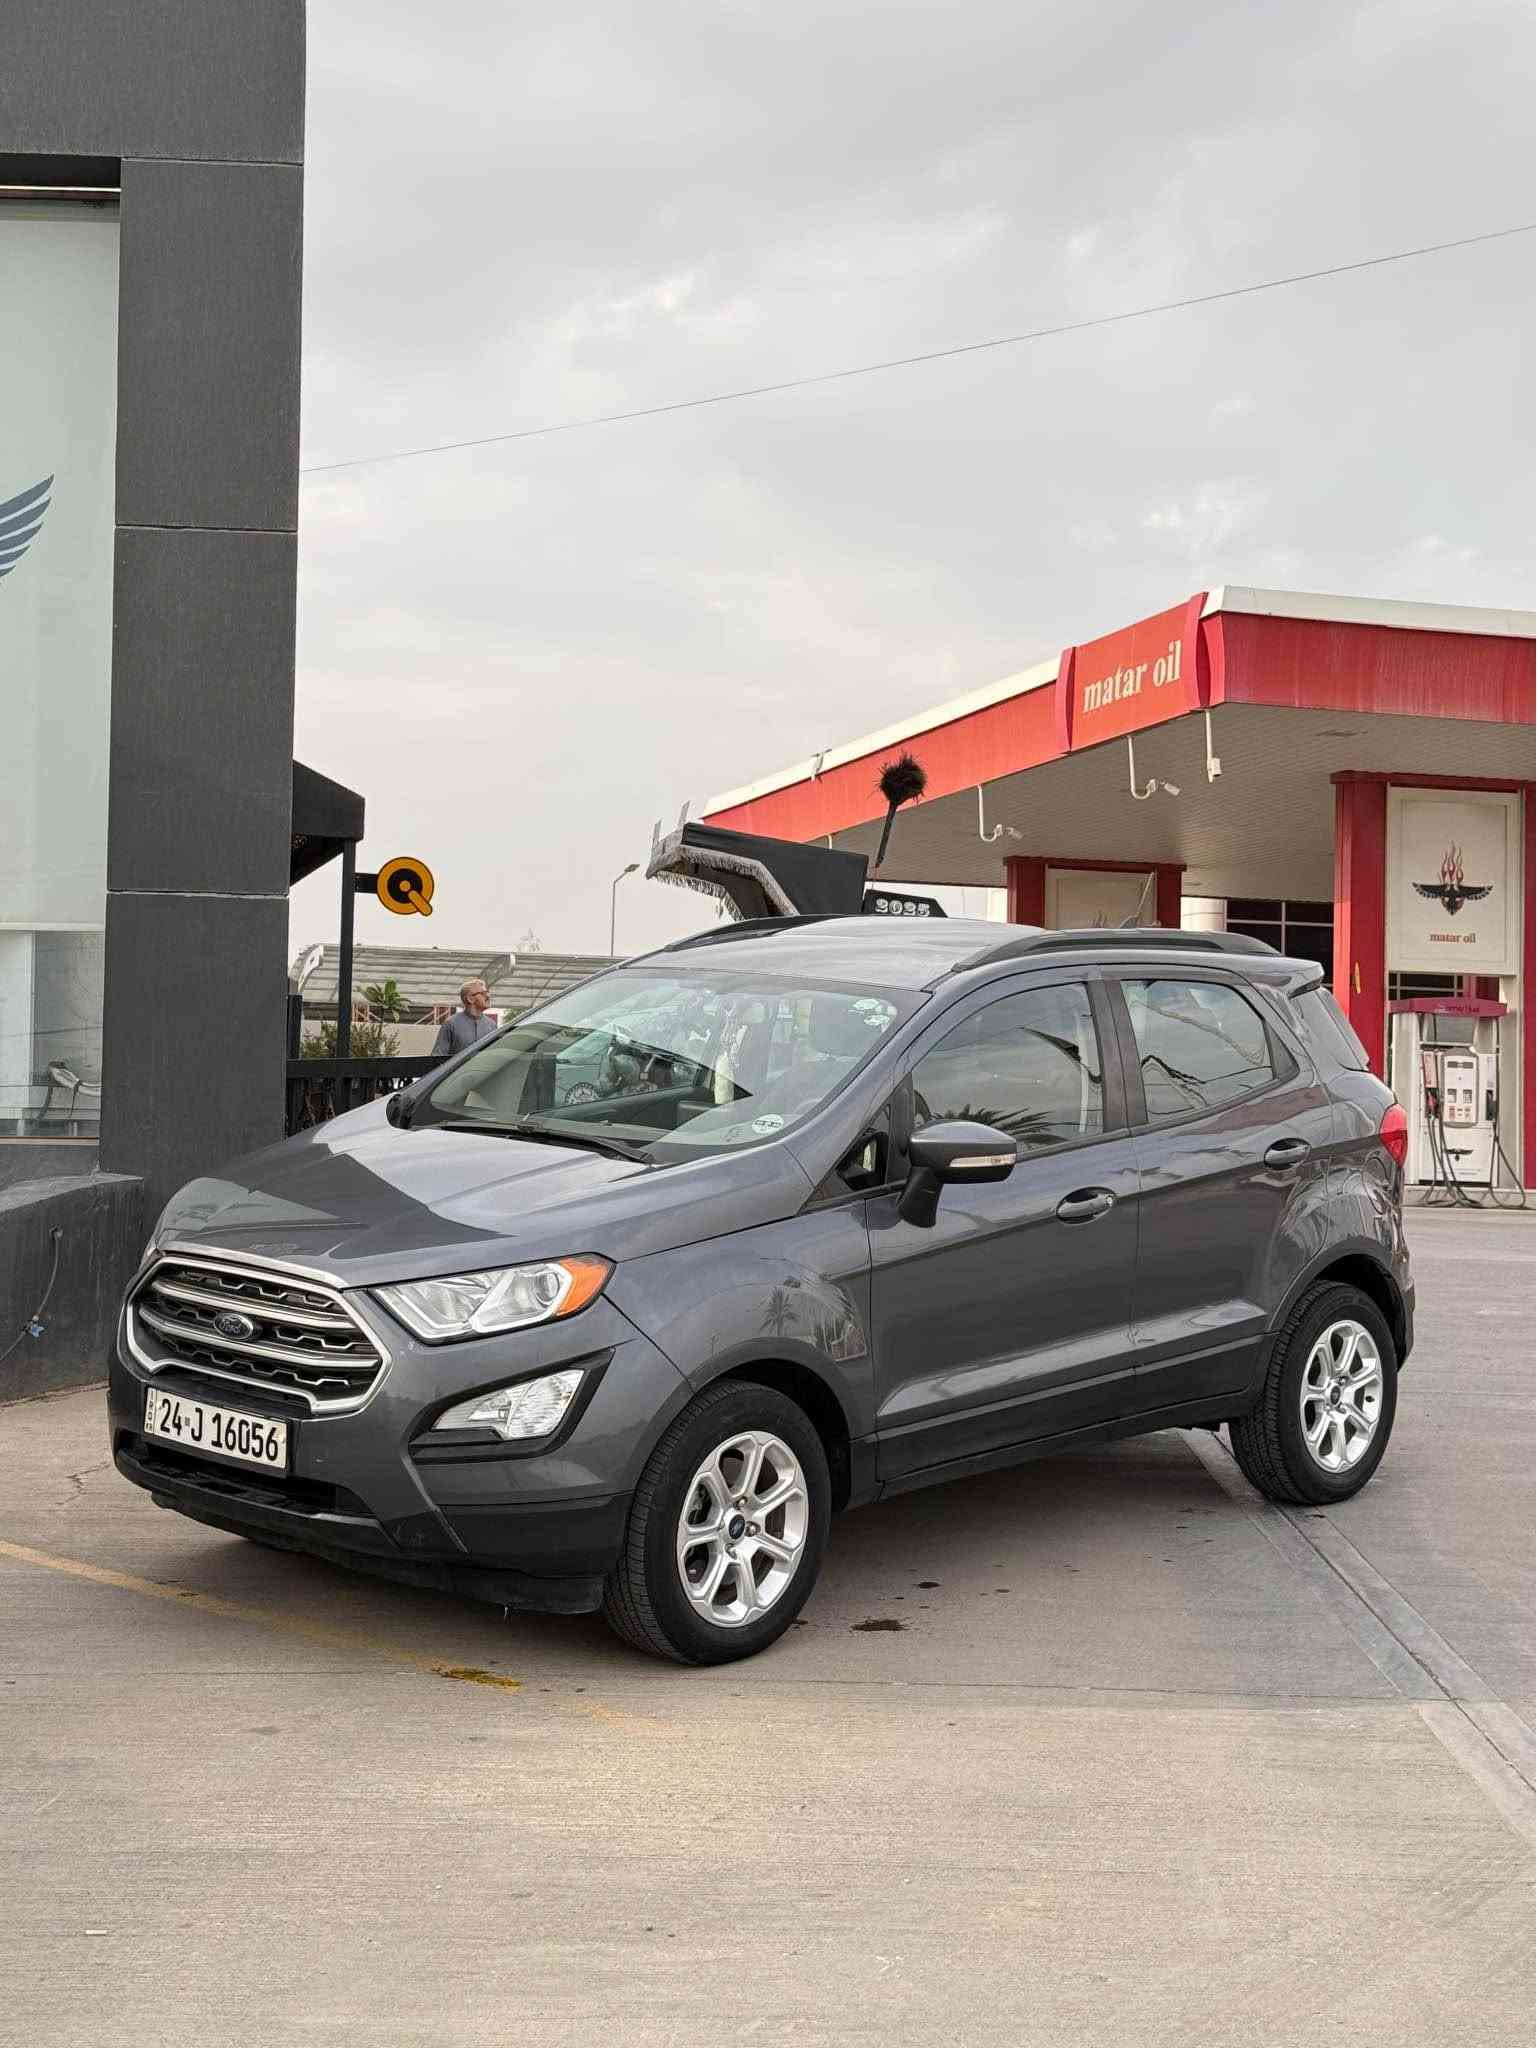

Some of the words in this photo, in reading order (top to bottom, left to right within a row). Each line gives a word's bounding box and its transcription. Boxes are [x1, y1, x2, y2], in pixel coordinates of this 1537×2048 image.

[1083, 664, 1148, 713] matar
[1153, 640, 1182, 687] oil
[875, 898, 930, 917] 2025
[1430, 934, 1462, 943] matar
[1463, 933, 1476, 944] oil
[211, 1413, 279, 1461] 16056
